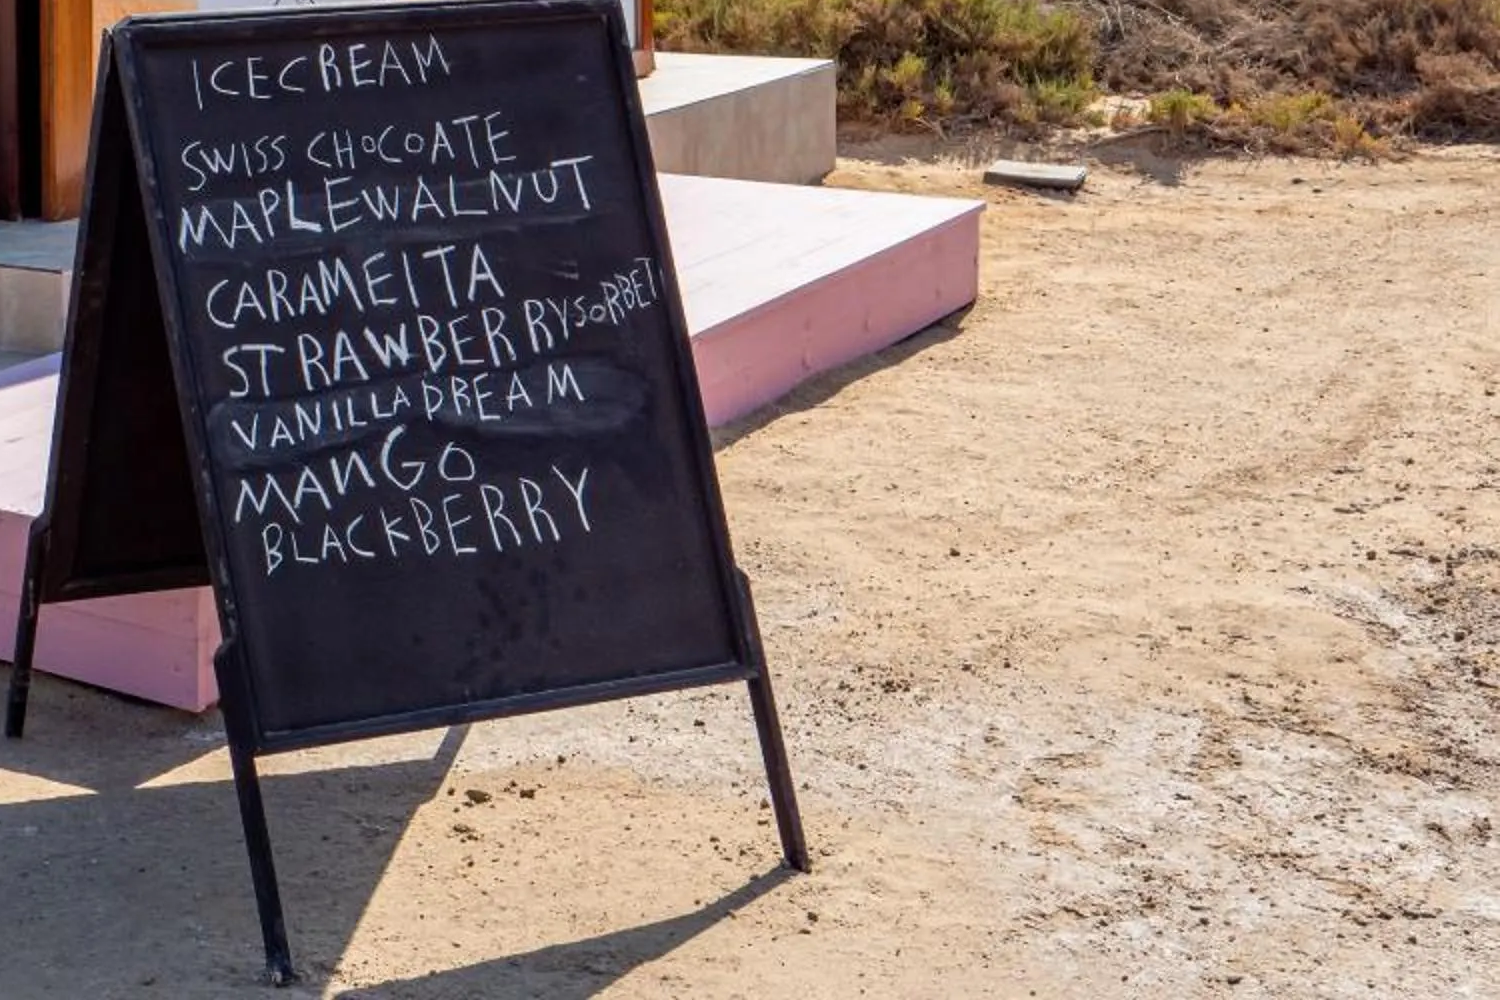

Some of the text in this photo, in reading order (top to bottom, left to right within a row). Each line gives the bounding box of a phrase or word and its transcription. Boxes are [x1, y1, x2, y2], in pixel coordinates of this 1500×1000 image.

[182, 134, 286, 190] SWISS
[235, 424, 475, 523] MANGO
[261, 464, 592, 575] BLACKBERRY
